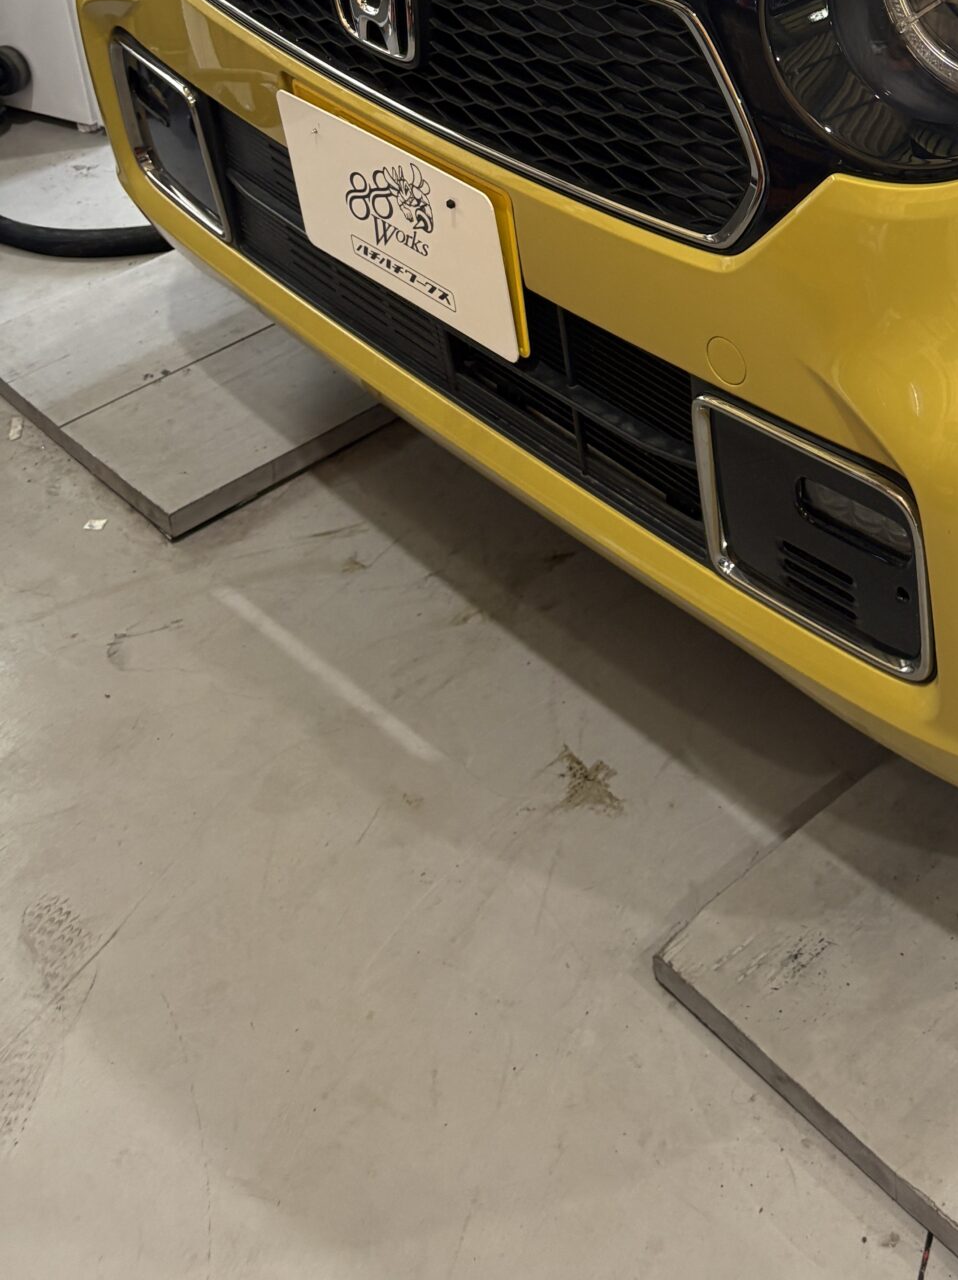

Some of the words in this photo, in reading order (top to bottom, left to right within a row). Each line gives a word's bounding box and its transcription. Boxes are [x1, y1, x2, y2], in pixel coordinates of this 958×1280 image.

[371, 214, 430, 257] Works
[356, 244, 452, 305] ハチハチワークス
